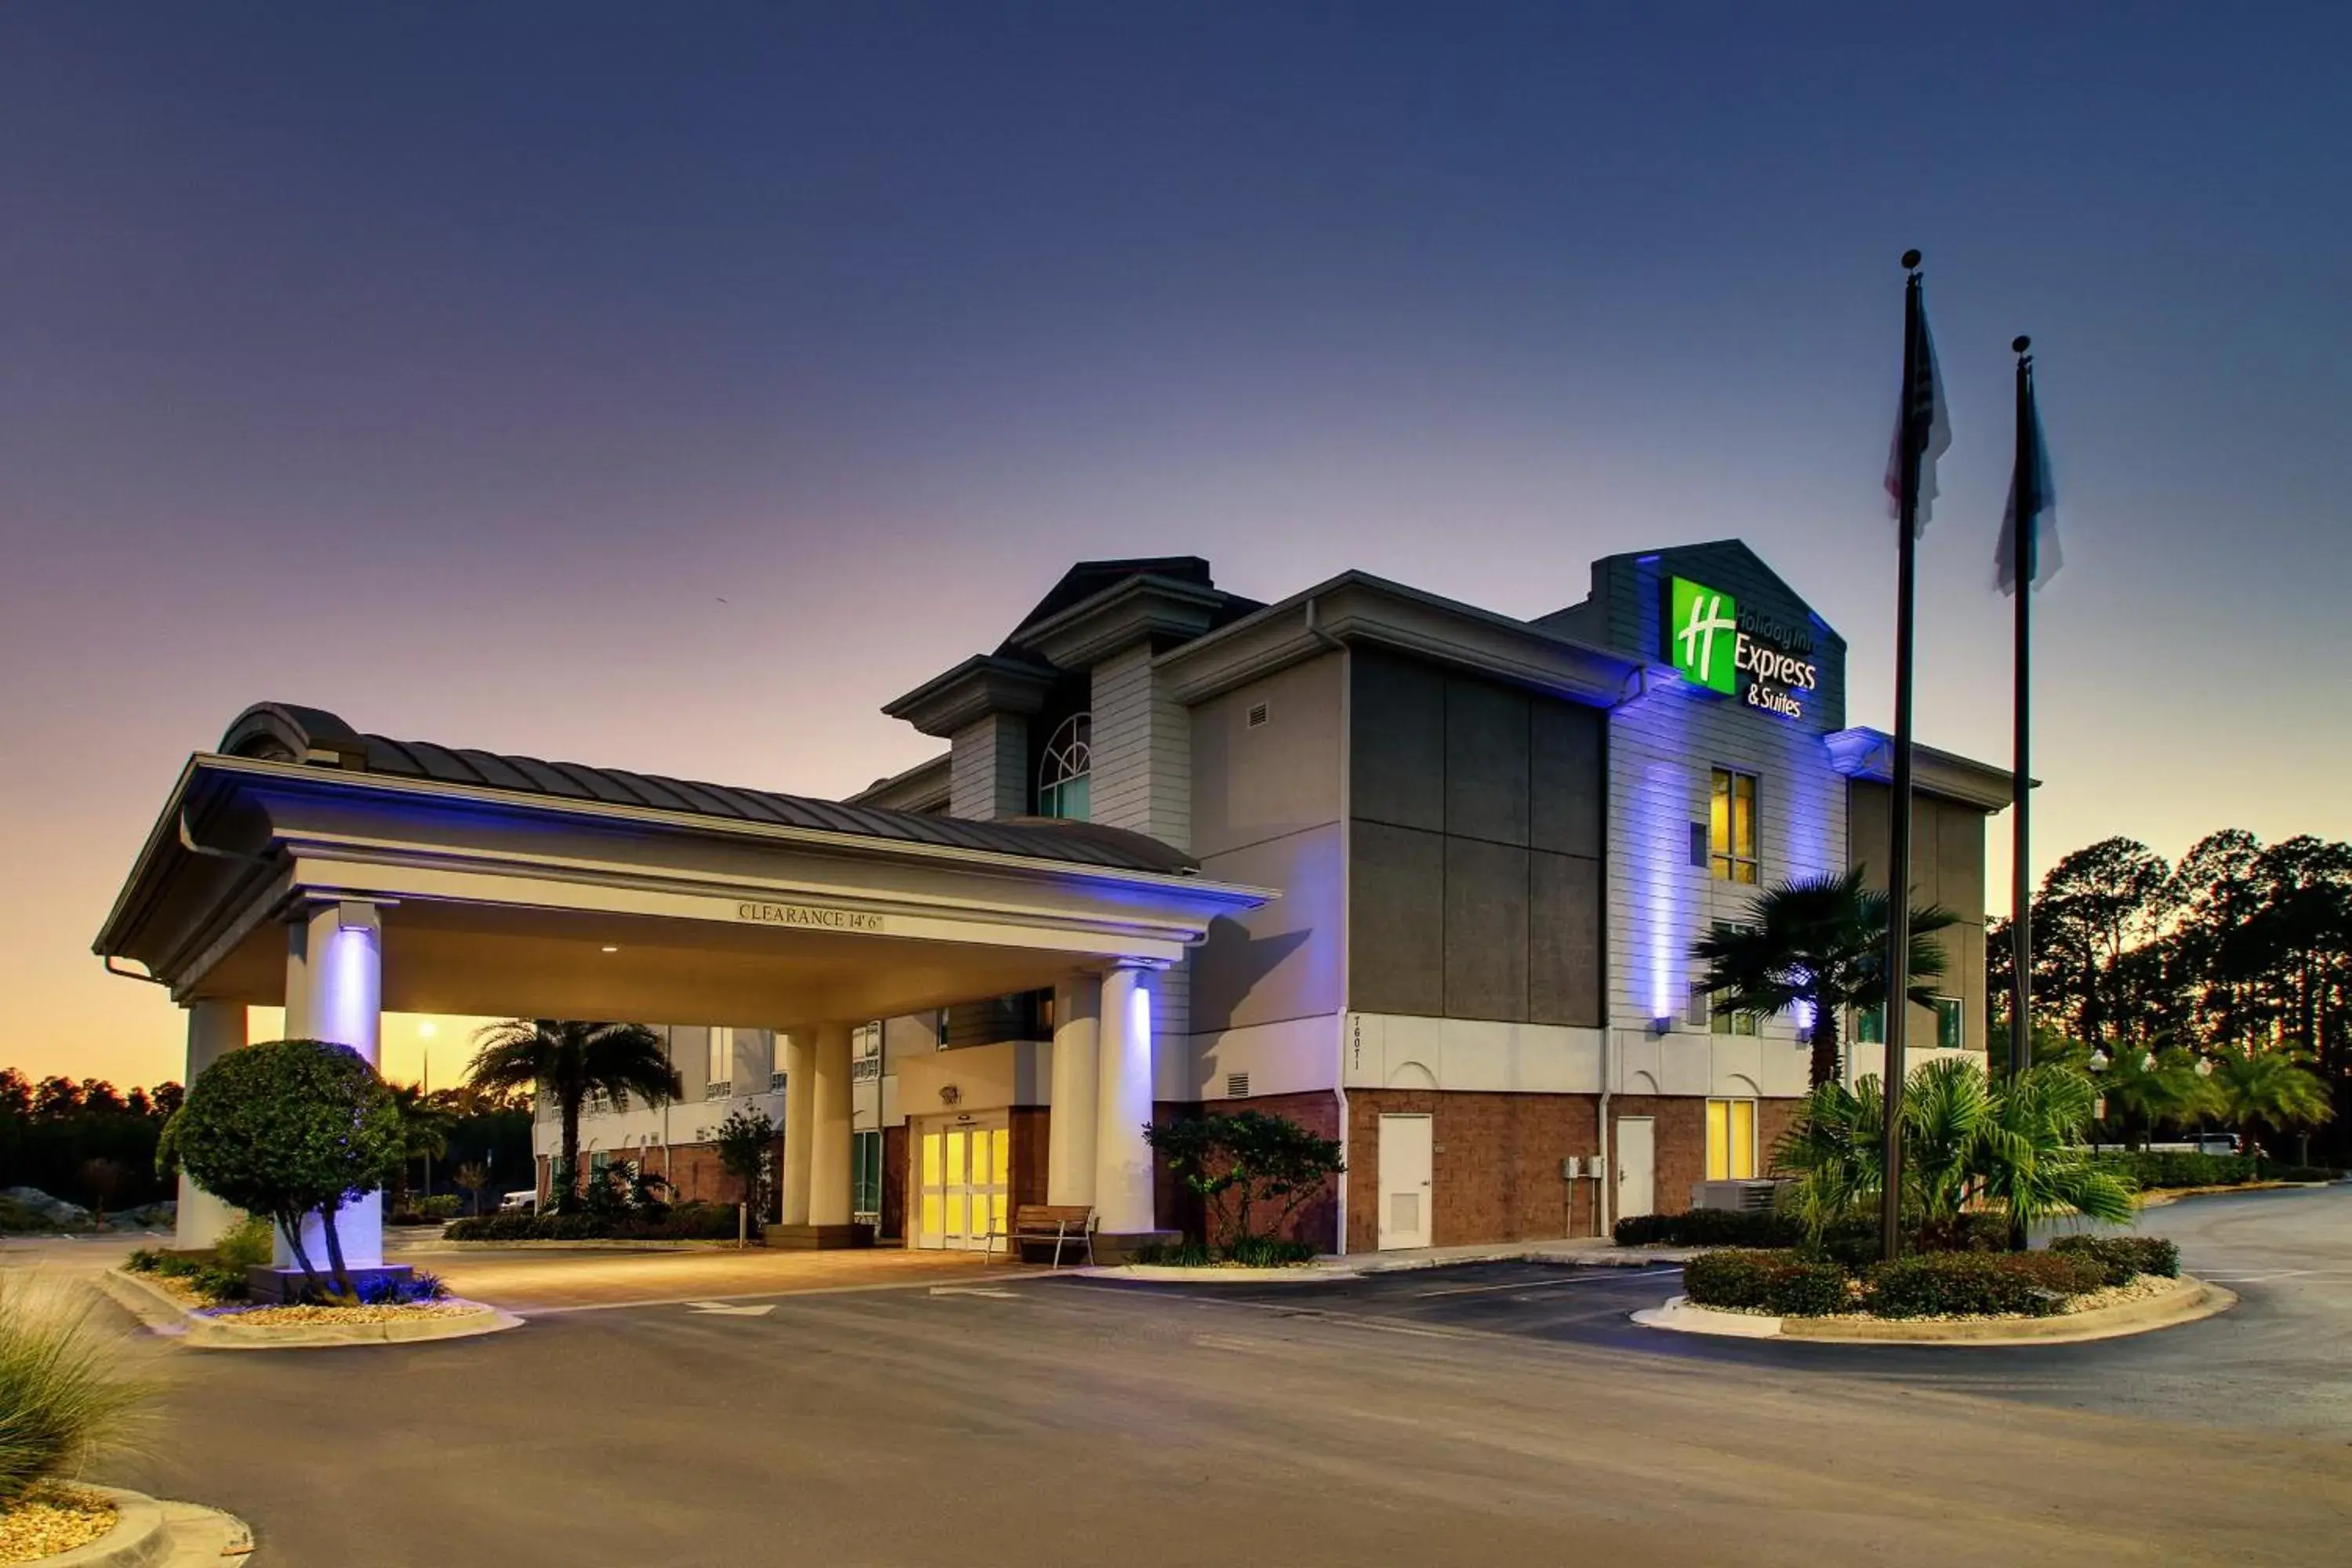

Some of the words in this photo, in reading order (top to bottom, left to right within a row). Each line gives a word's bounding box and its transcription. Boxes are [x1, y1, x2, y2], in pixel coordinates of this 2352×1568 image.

[1737, 604, 1792, 650] Holiday
[1734, 633, 1817, 690] Express
[1748, 683, 1759, 705] &
[1762, 688, 1802, 717] Suites
[739, 903, 844, 926] CLEARANCE
